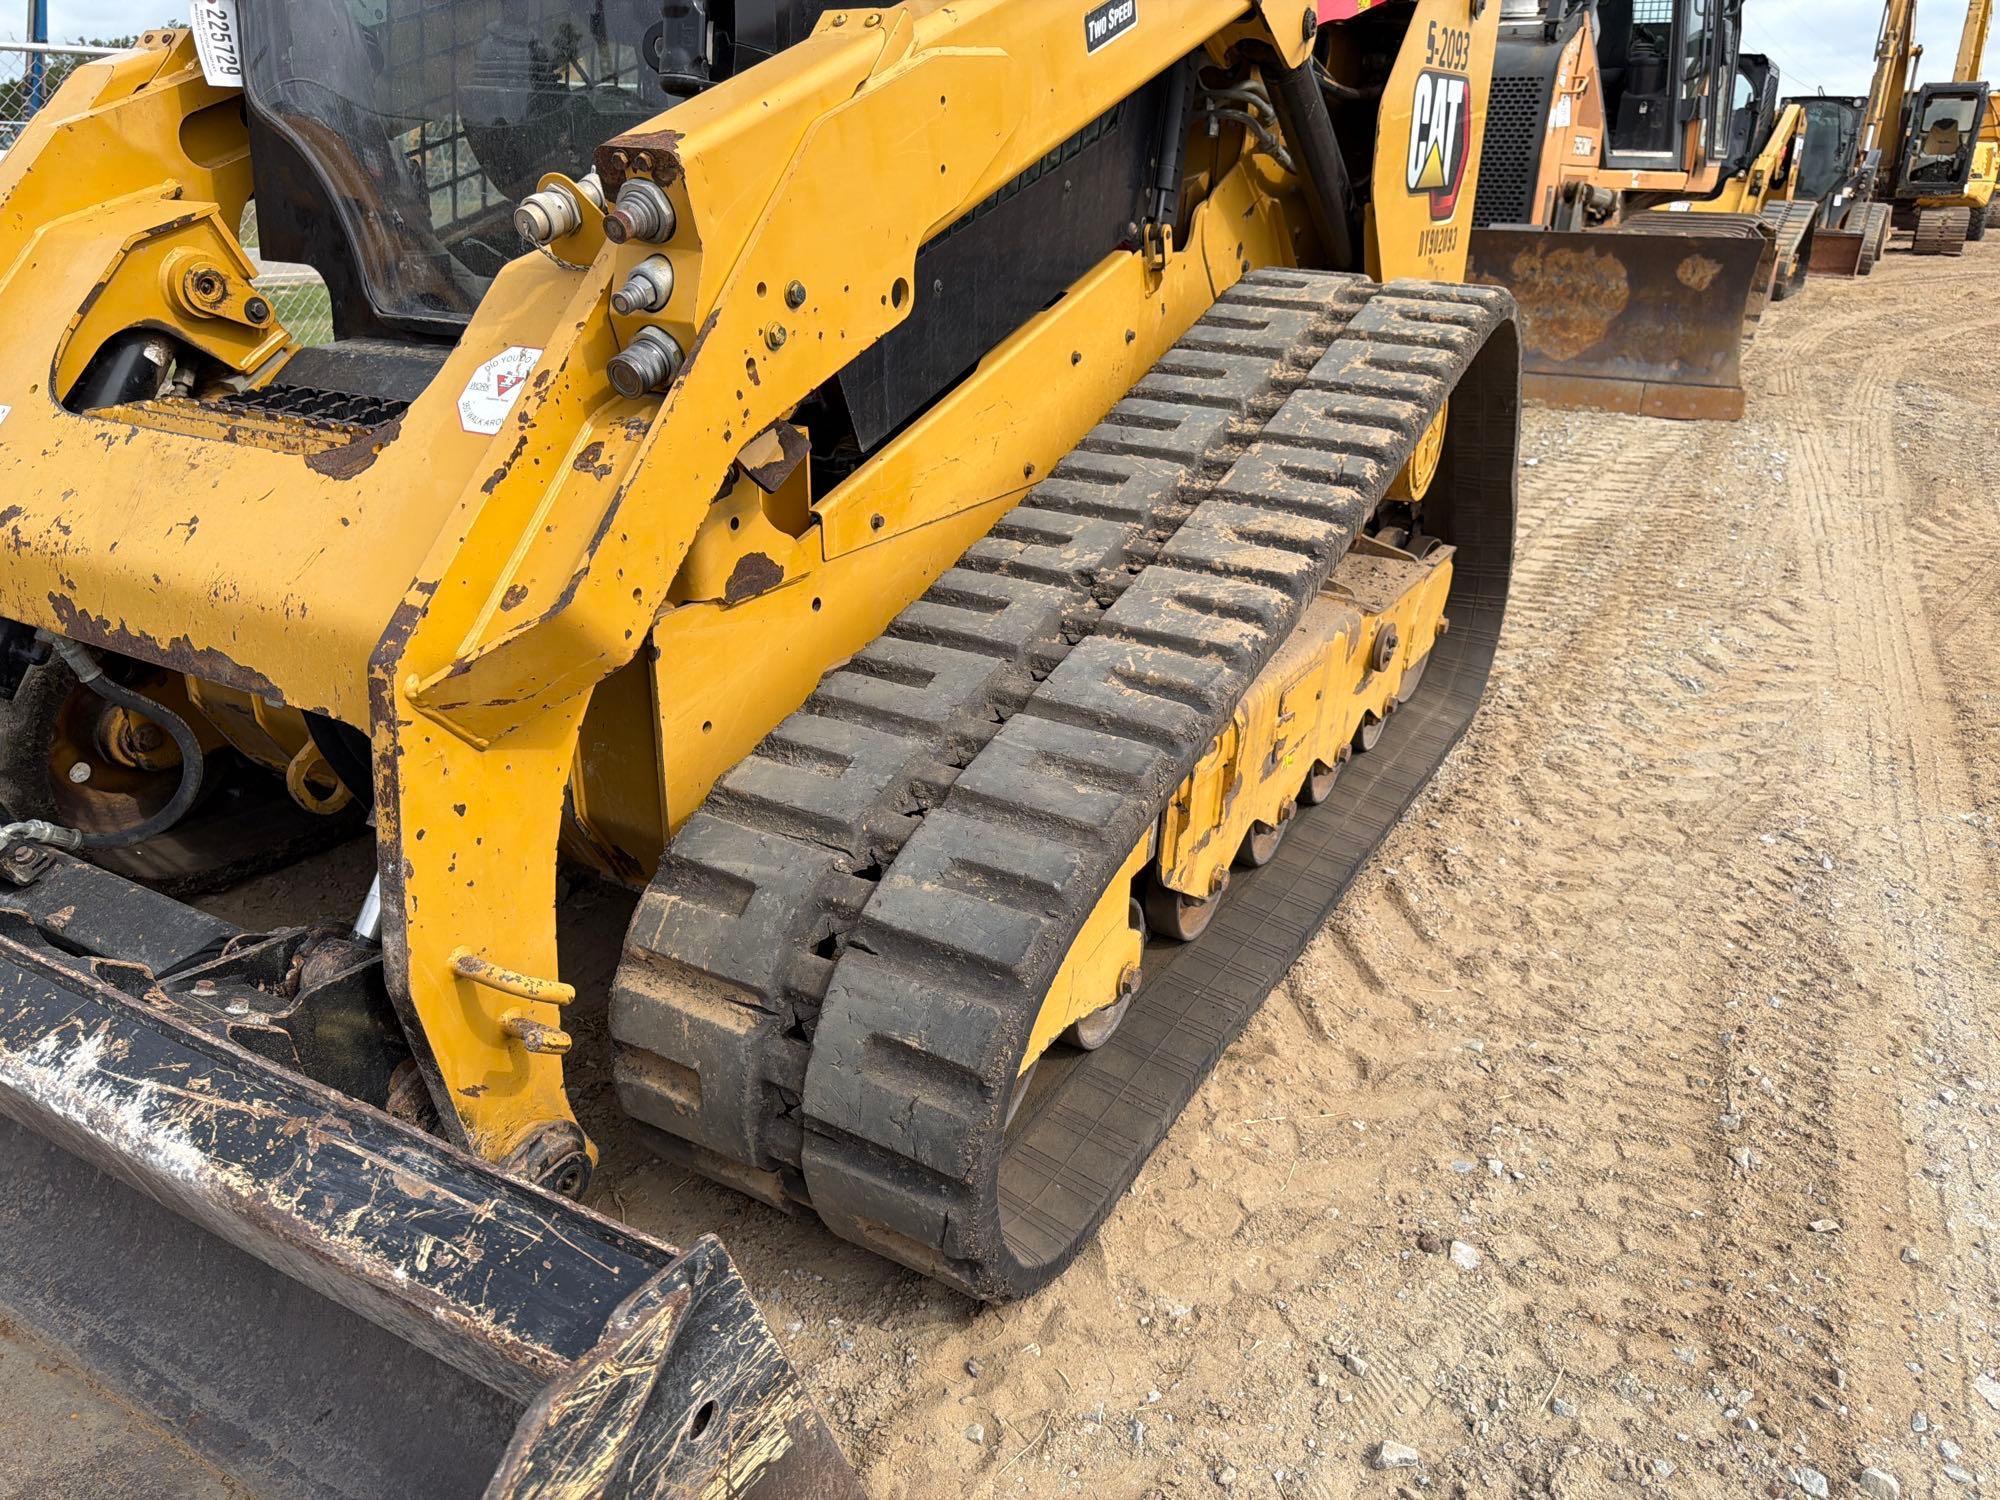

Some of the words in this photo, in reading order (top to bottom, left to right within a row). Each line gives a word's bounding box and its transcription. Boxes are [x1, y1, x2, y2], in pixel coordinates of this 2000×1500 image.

[1108, 0, 1133, 30] SPEED
[206, 9, 241, 75] 225729
[1408, 73, 1465, 189] CAT
[484, 361, 499, 372] DID
[501, 354, 519, 363] YOU
